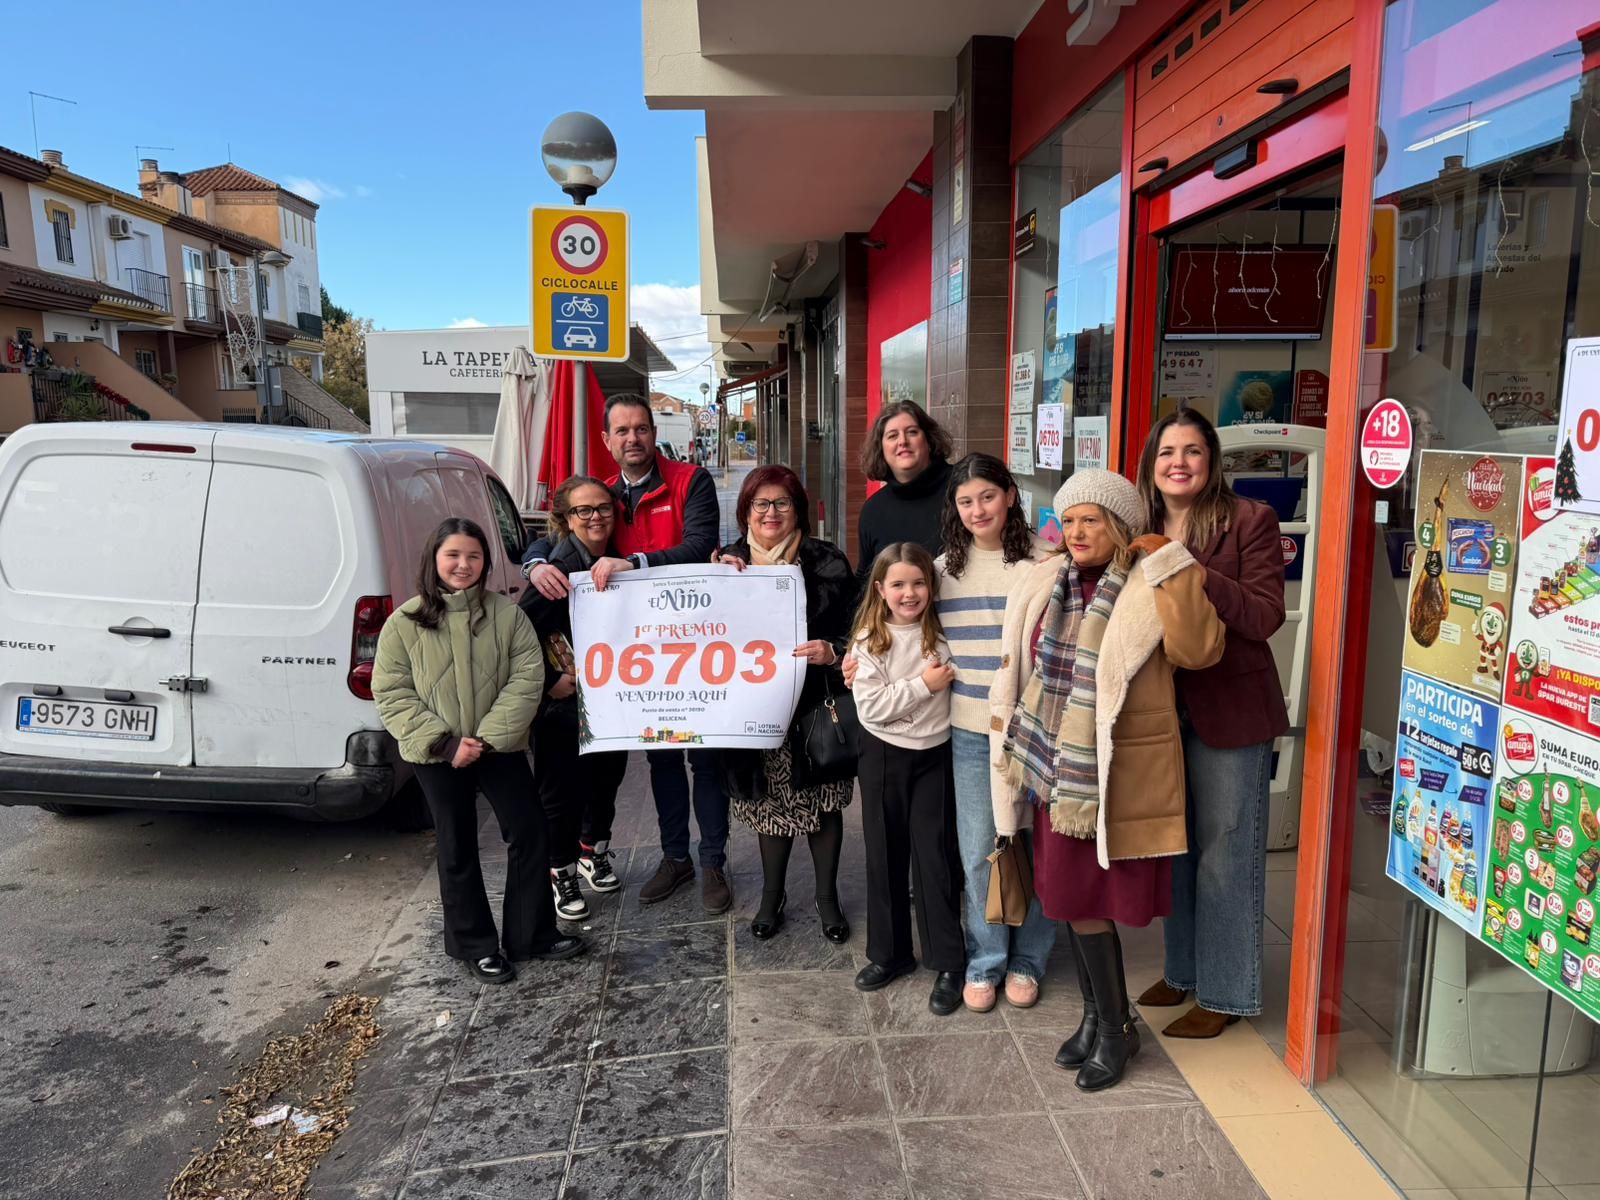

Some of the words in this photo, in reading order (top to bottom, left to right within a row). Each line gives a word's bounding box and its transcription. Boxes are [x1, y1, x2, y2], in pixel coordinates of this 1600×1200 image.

[563, 235, 596, 256] 30
[541, 277, 618, 291] CICLOCALLE
[422, 351, 448, 366] LA
[701, 412, 711, 421] 20
[1373, 410, 1400, 437] +18
[1039, 430, 1059, 446] 06703
[1466, 470, 1504, 495] Navidad
[1422, 531, 1430, 541] 4
[1495, 544, 1504, 559] 3
[648, 597, 659, 608] El
[659, 588, 711, 611] Niño
[635, 624, 652, 638] 1er
[655, 620, 727, 640] PREMIO
[1564, 614, 1589, 627] estos
[1568, 625, 1583, 634] hasta
[262, 656, 337, 666] PARTNER
[585, 640, 777, 688] 06703
[1557, 669, 1571, 681] ¡YA
[616, 689, 685, 703] VENDIDO
[686, 687, 728, 704] AQUÍ
[1406, 678, 1483, 728] PARTICIPA
[1537, 690, 1555, 703] SPAR
[1555, 696, 1587, 714] SURESTE
[36, 703, 95, 728] 9573
[104, 708, 149, 732] GNH
[1406, 702, 1416, 713] en
[1418, 706, 1426, 718] el
[1428, 711, 1458, 731] sorteo
[1460, 723, 1473, 738] de
[1405, 716, 1420, 741] 12
[1540, 738, 1568, 759] SUMA
[1570, 751, 1600, 772] EURO
